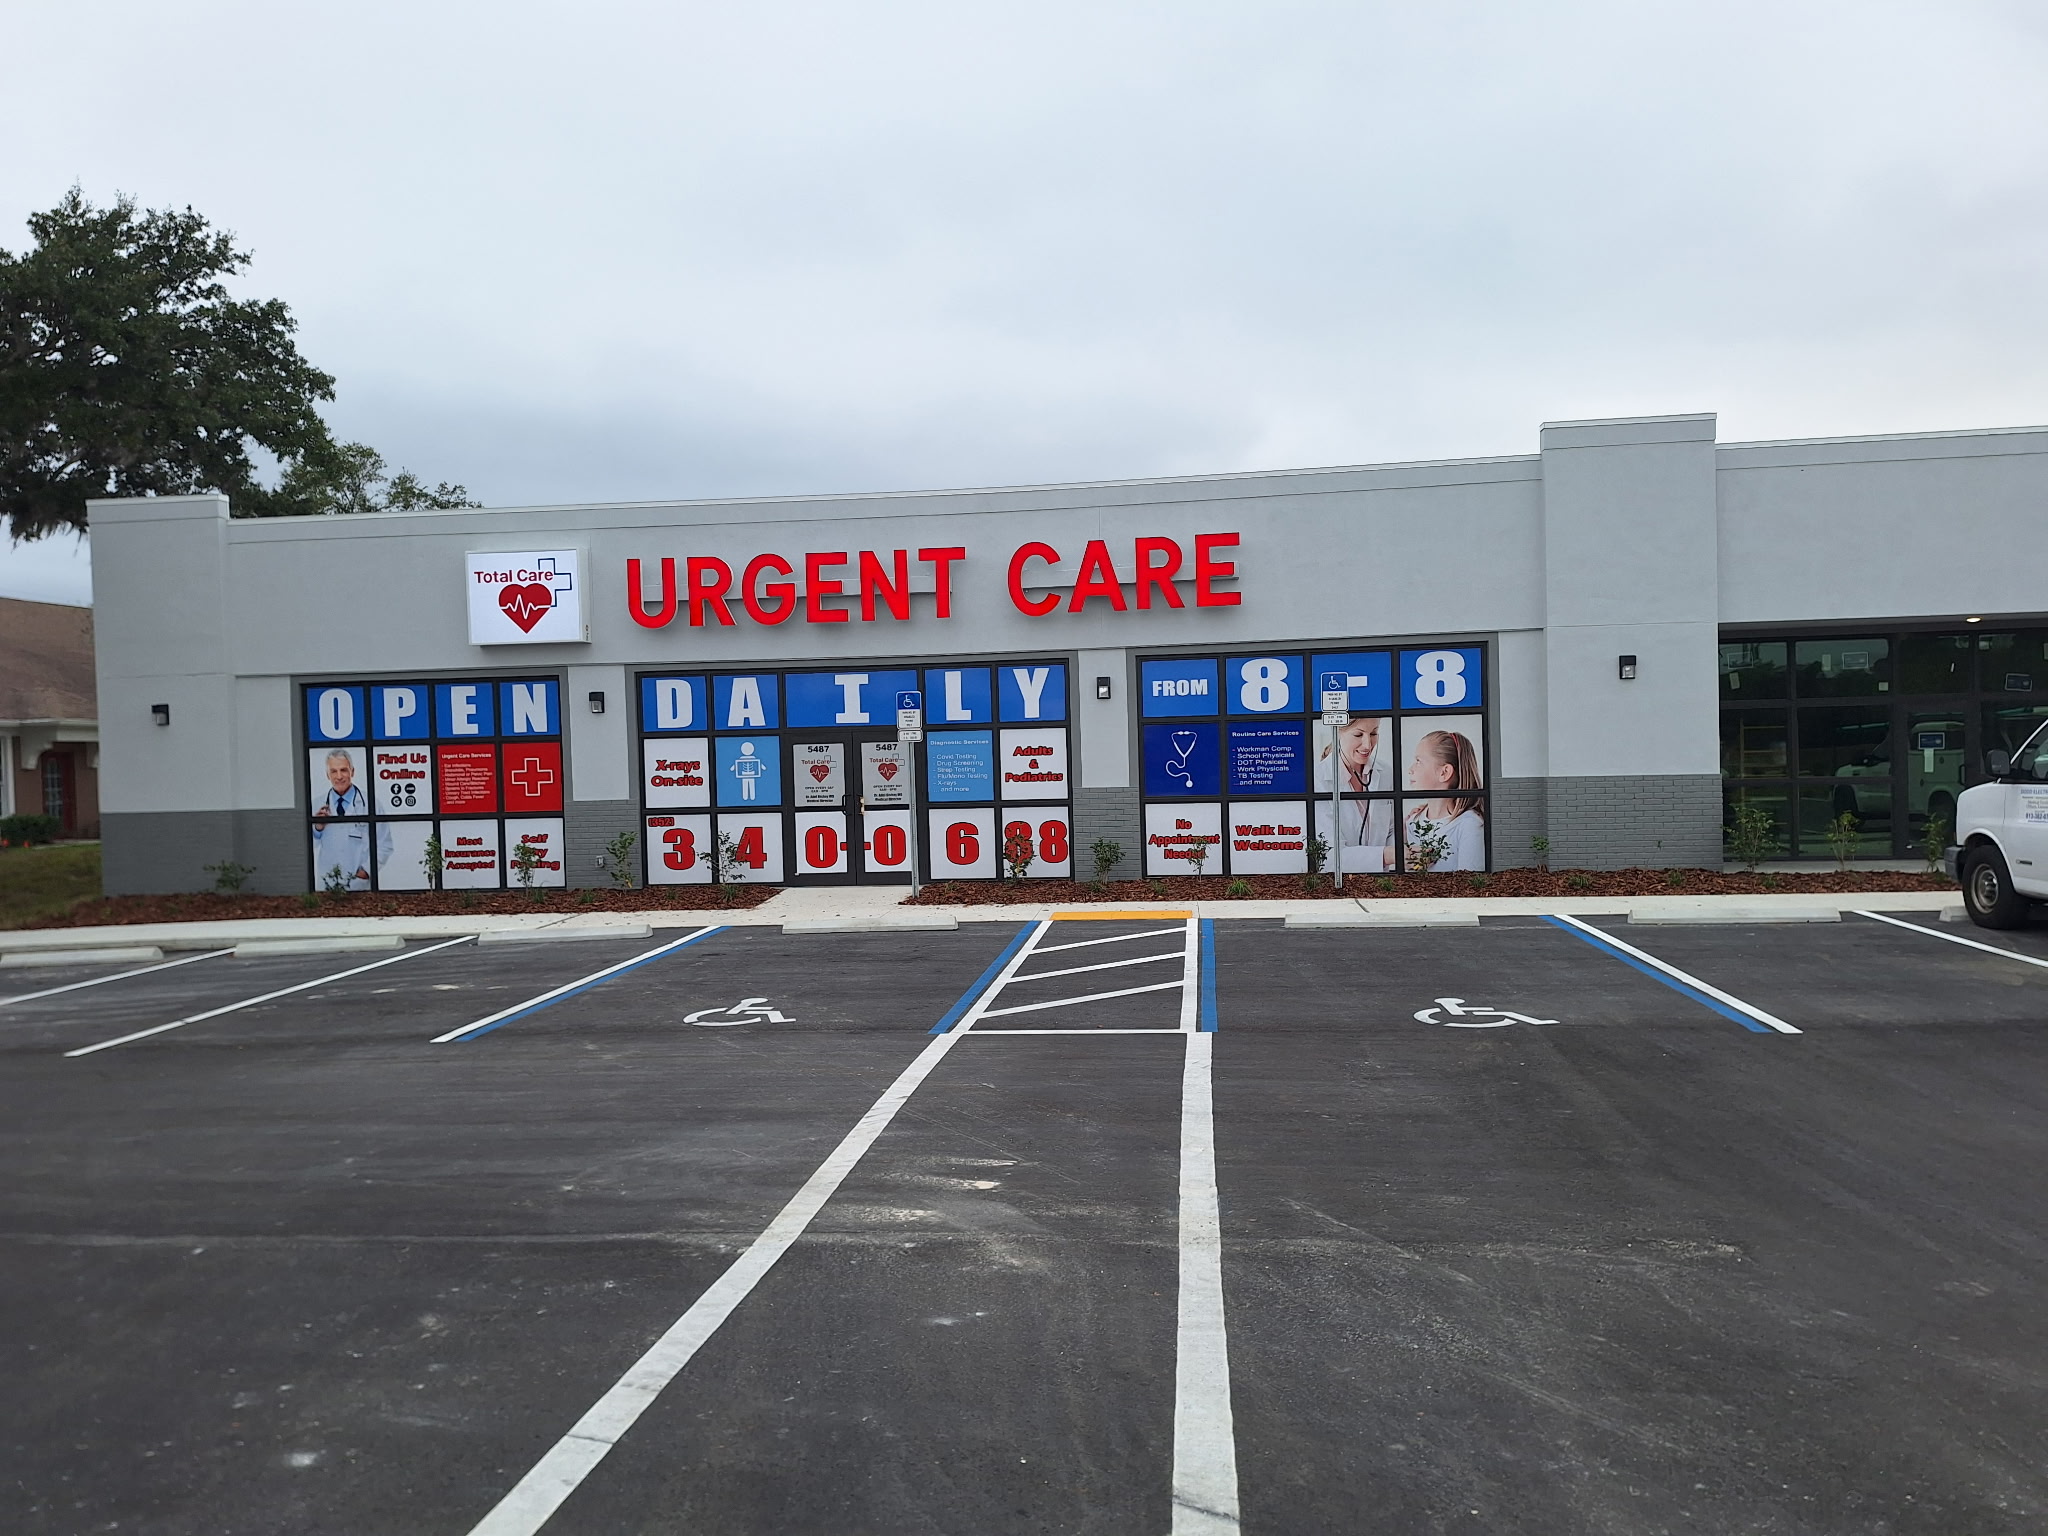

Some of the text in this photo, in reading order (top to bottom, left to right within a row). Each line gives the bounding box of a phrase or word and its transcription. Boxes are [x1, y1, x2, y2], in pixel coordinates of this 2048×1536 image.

[474, 569, 553, 583] Total Care
[626, 532, 1242, 630] URGENT CARE
[1152, 678, 1208, 697] FROM
[318, 683, 548, 739] OPEN
[1013, 746, 1053, 756] Adults
[377, 753, 428, 765] Find Us
[1029, 759, 1039, 769] &
[655, 759, 701, 773] X-rays
[380, 769, 426, 780] Online
[1005, 771, 1063, 782] Pediatrics
[651, 775, 703, 787] On-site
[648, 817, 675, 827] (352)
[1176, 819, 1192, 830] No
[1235, 825, 1301, 836] Walk Ins
[456, 836, 483, 846] Most
[521, 834, 549, 844] Self
[1234, 840, 1304, 851] Welcome
[444, 849, 496, 858] Insurance
[446, 860, 495, 871] Accepted
[510, 860, 560, 871] Ping
